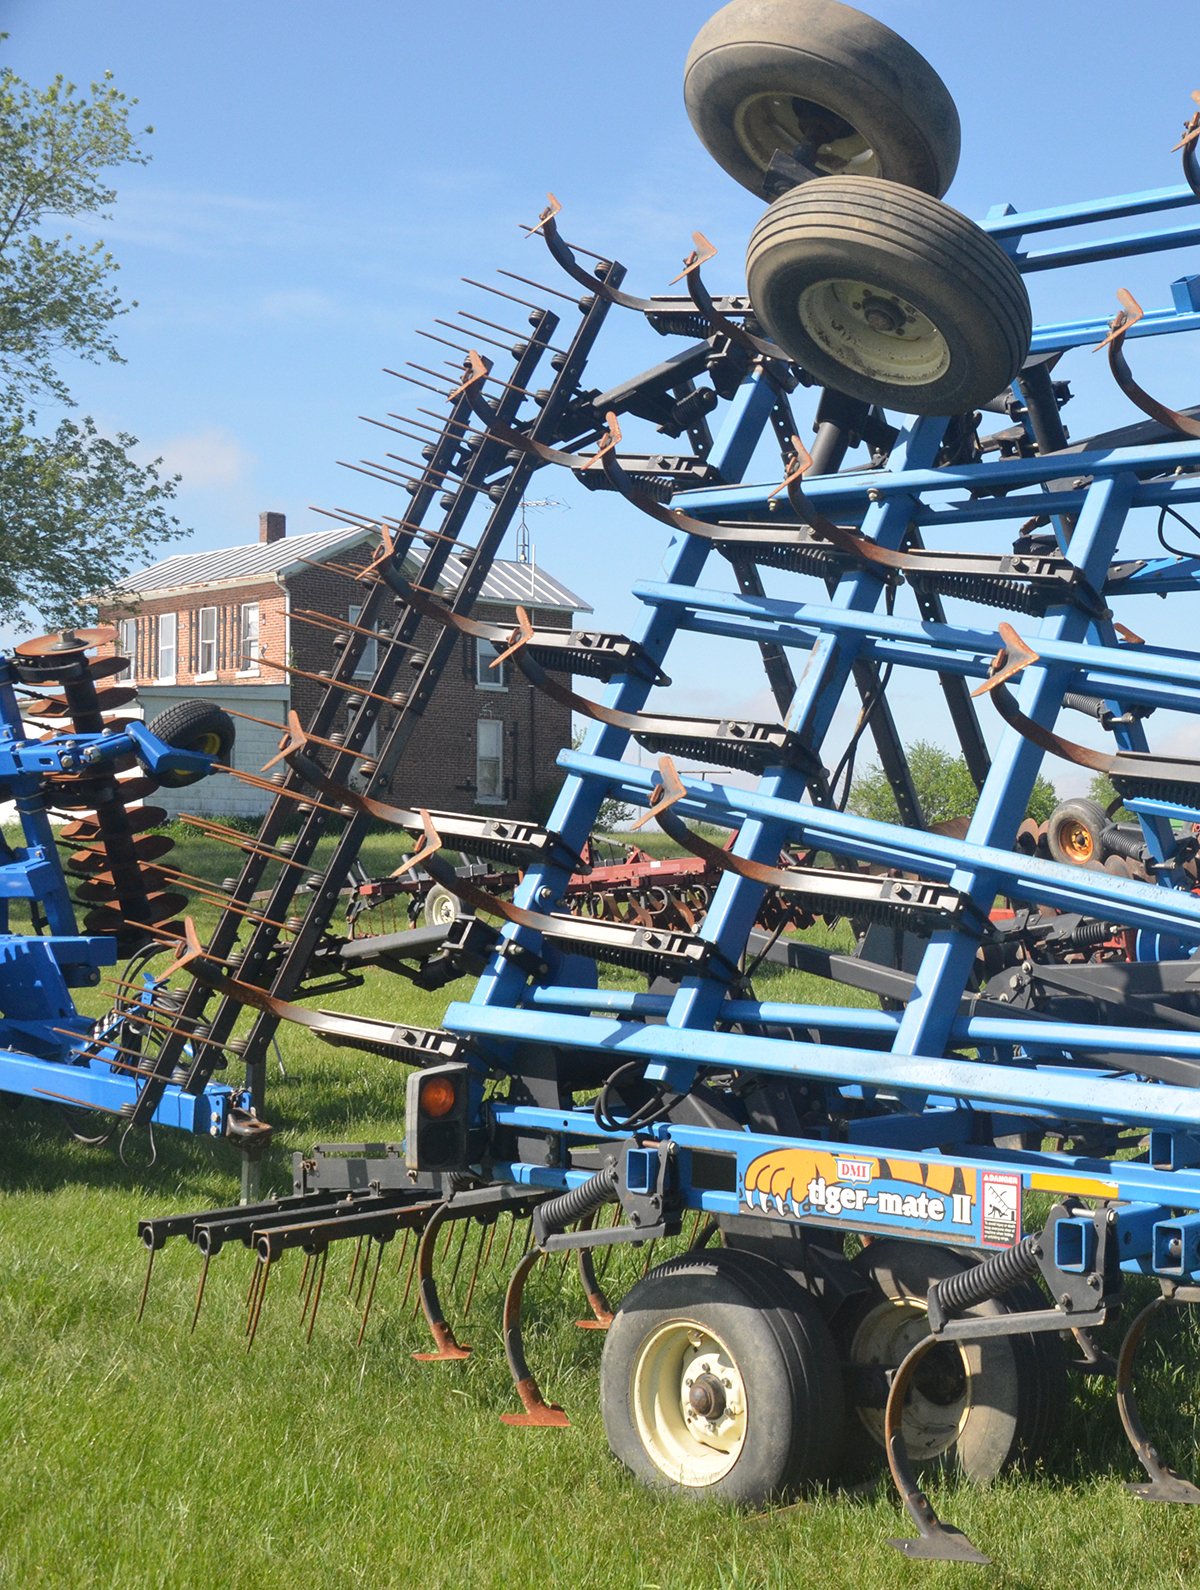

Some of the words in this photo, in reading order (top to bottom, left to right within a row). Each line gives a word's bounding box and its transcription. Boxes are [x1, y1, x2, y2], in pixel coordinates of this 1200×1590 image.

[841, 1163, 867, 1178] DMI
[989, 1173, 1018, 1185] DANGER
[807, 1177, 945, 1221] tiger-mate
